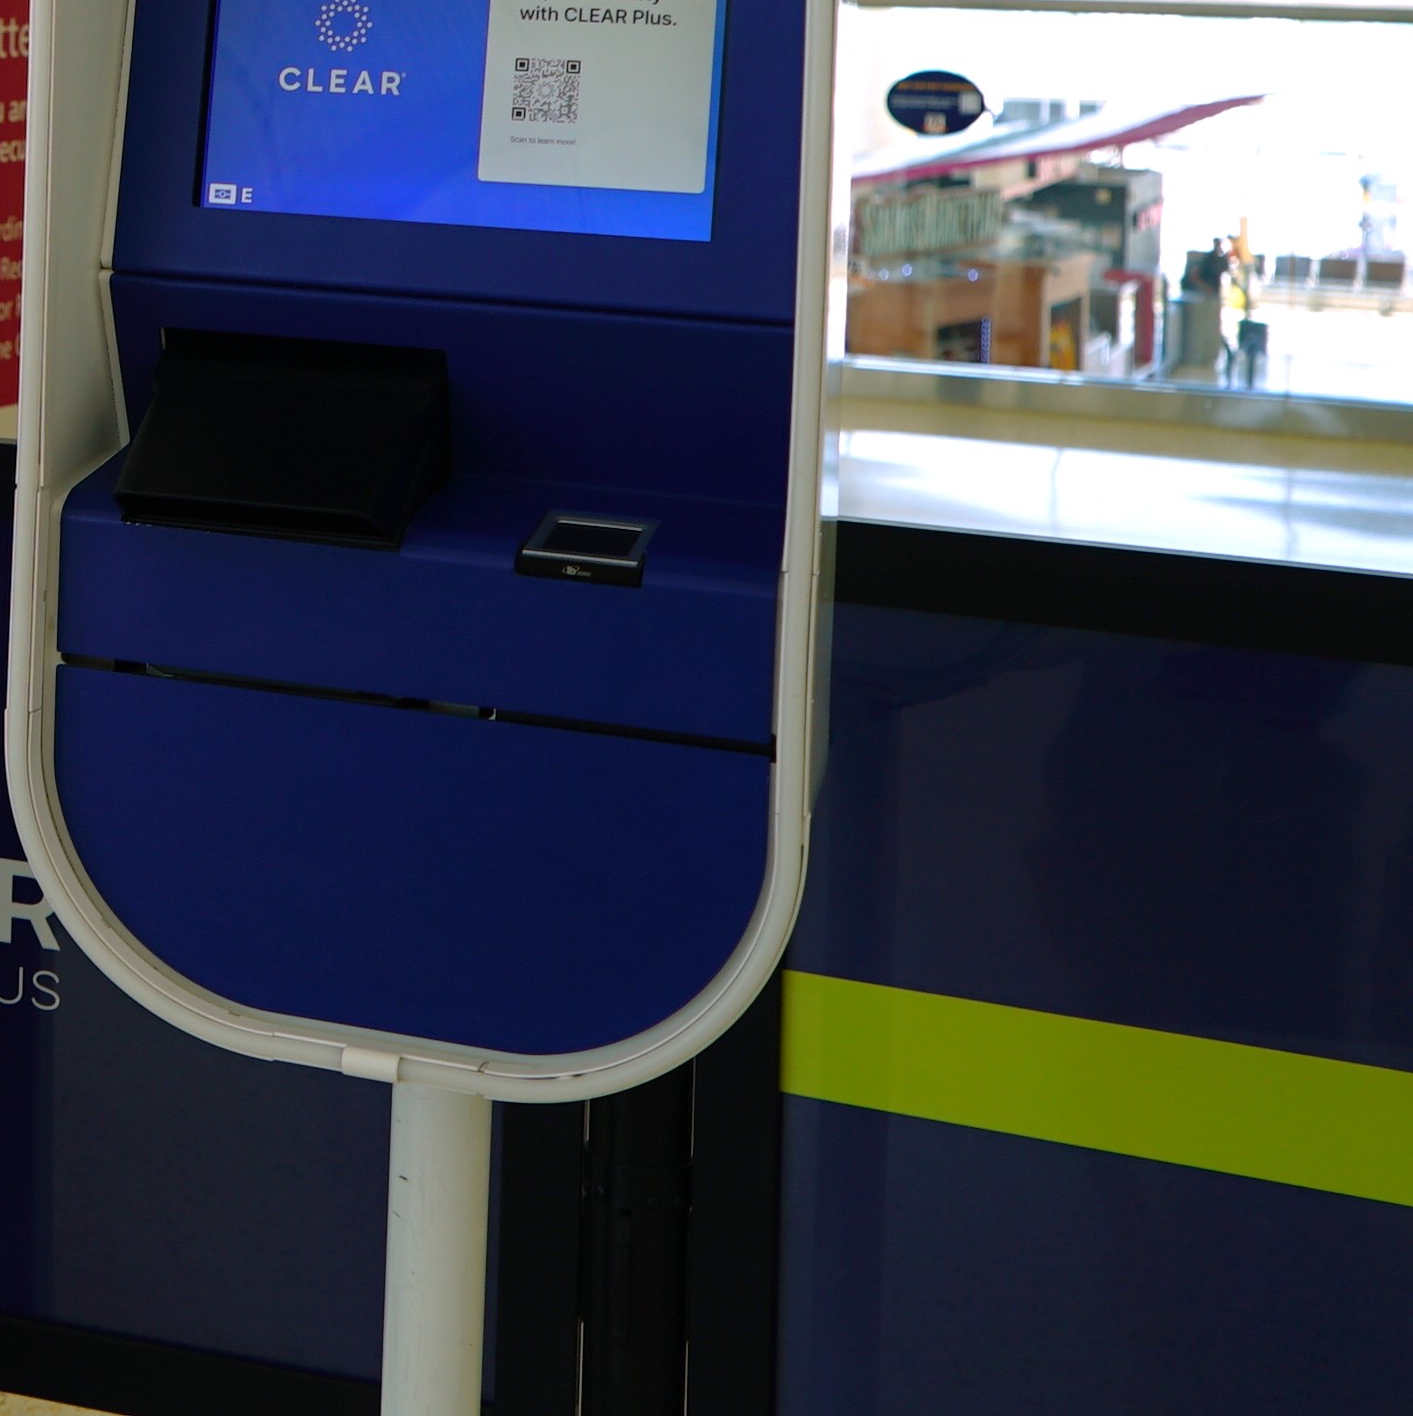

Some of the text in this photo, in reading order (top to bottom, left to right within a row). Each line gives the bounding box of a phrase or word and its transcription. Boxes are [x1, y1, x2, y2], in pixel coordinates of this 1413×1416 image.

[520, 7, 677, 26] with CLEAR Plus.
[241, 188, 253, 204] E
